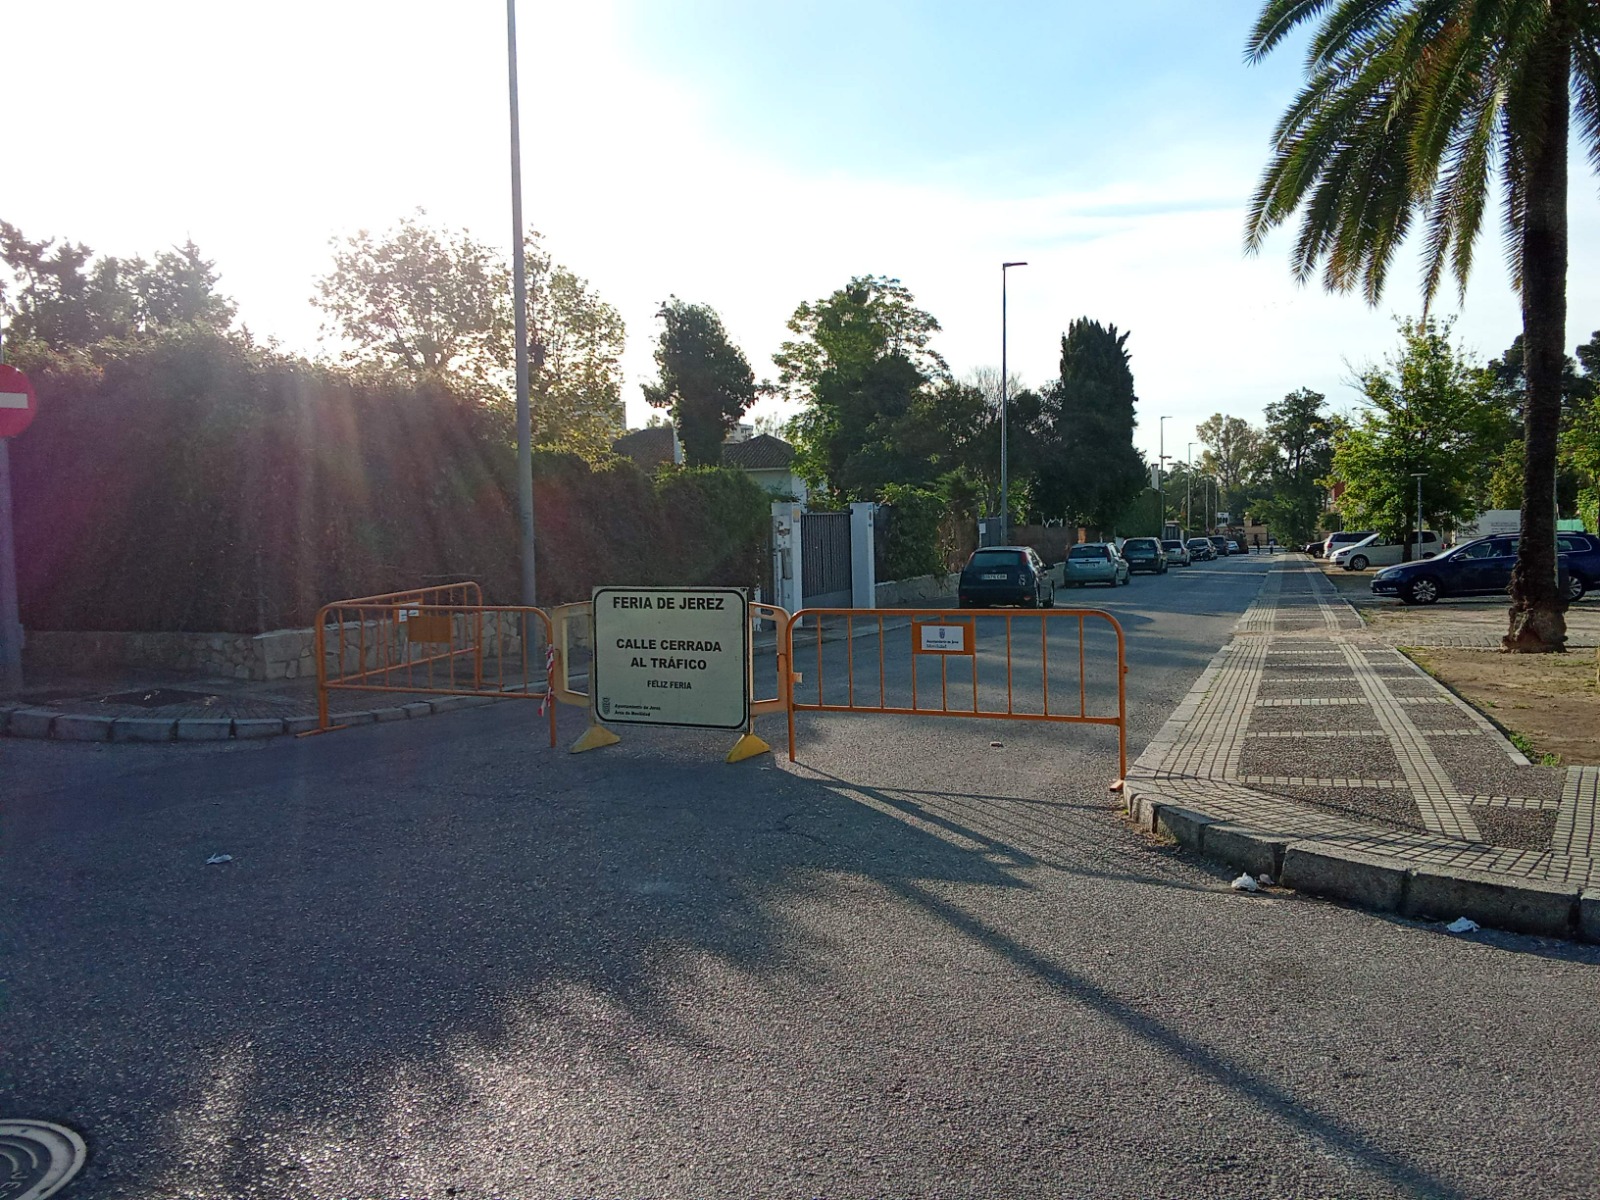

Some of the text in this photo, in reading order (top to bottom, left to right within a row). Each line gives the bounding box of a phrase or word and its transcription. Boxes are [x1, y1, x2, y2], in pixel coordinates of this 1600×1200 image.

[613, 596, 725, 611] FERIA DE JEREZ
[616, 638, 722, 652] CALLE CERRADA
[630, 656, 707, 670] AL TRÁFICO
[669, 680, 692, 690] FERIA
